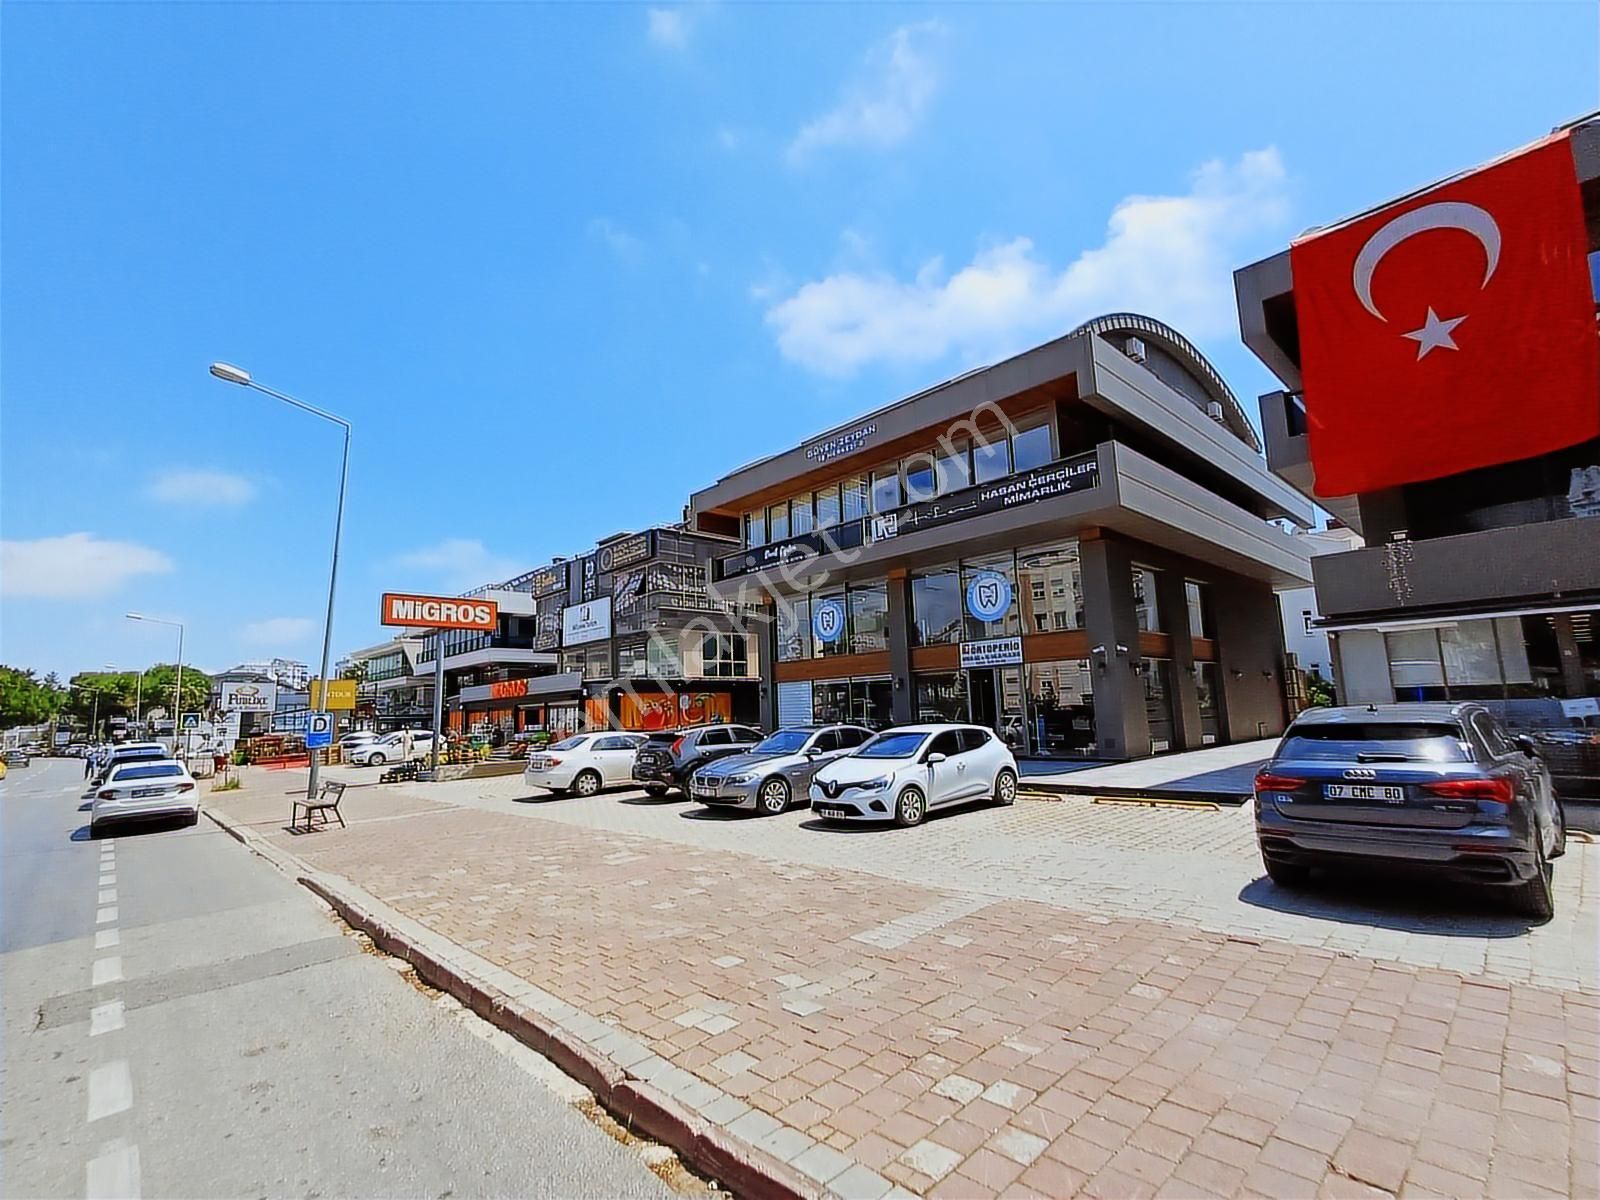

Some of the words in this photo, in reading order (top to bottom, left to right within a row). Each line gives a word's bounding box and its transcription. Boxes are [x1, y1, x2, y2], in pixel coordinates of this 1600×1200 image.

[981, 480, 1027, 501] HASAN
[1004, 480, 1072, 506] MİMARLIK
[391, 599, 491, 624] MiGROS
[313, 717, 327, 732] D
[1329, 785, 1343, 797] 07
